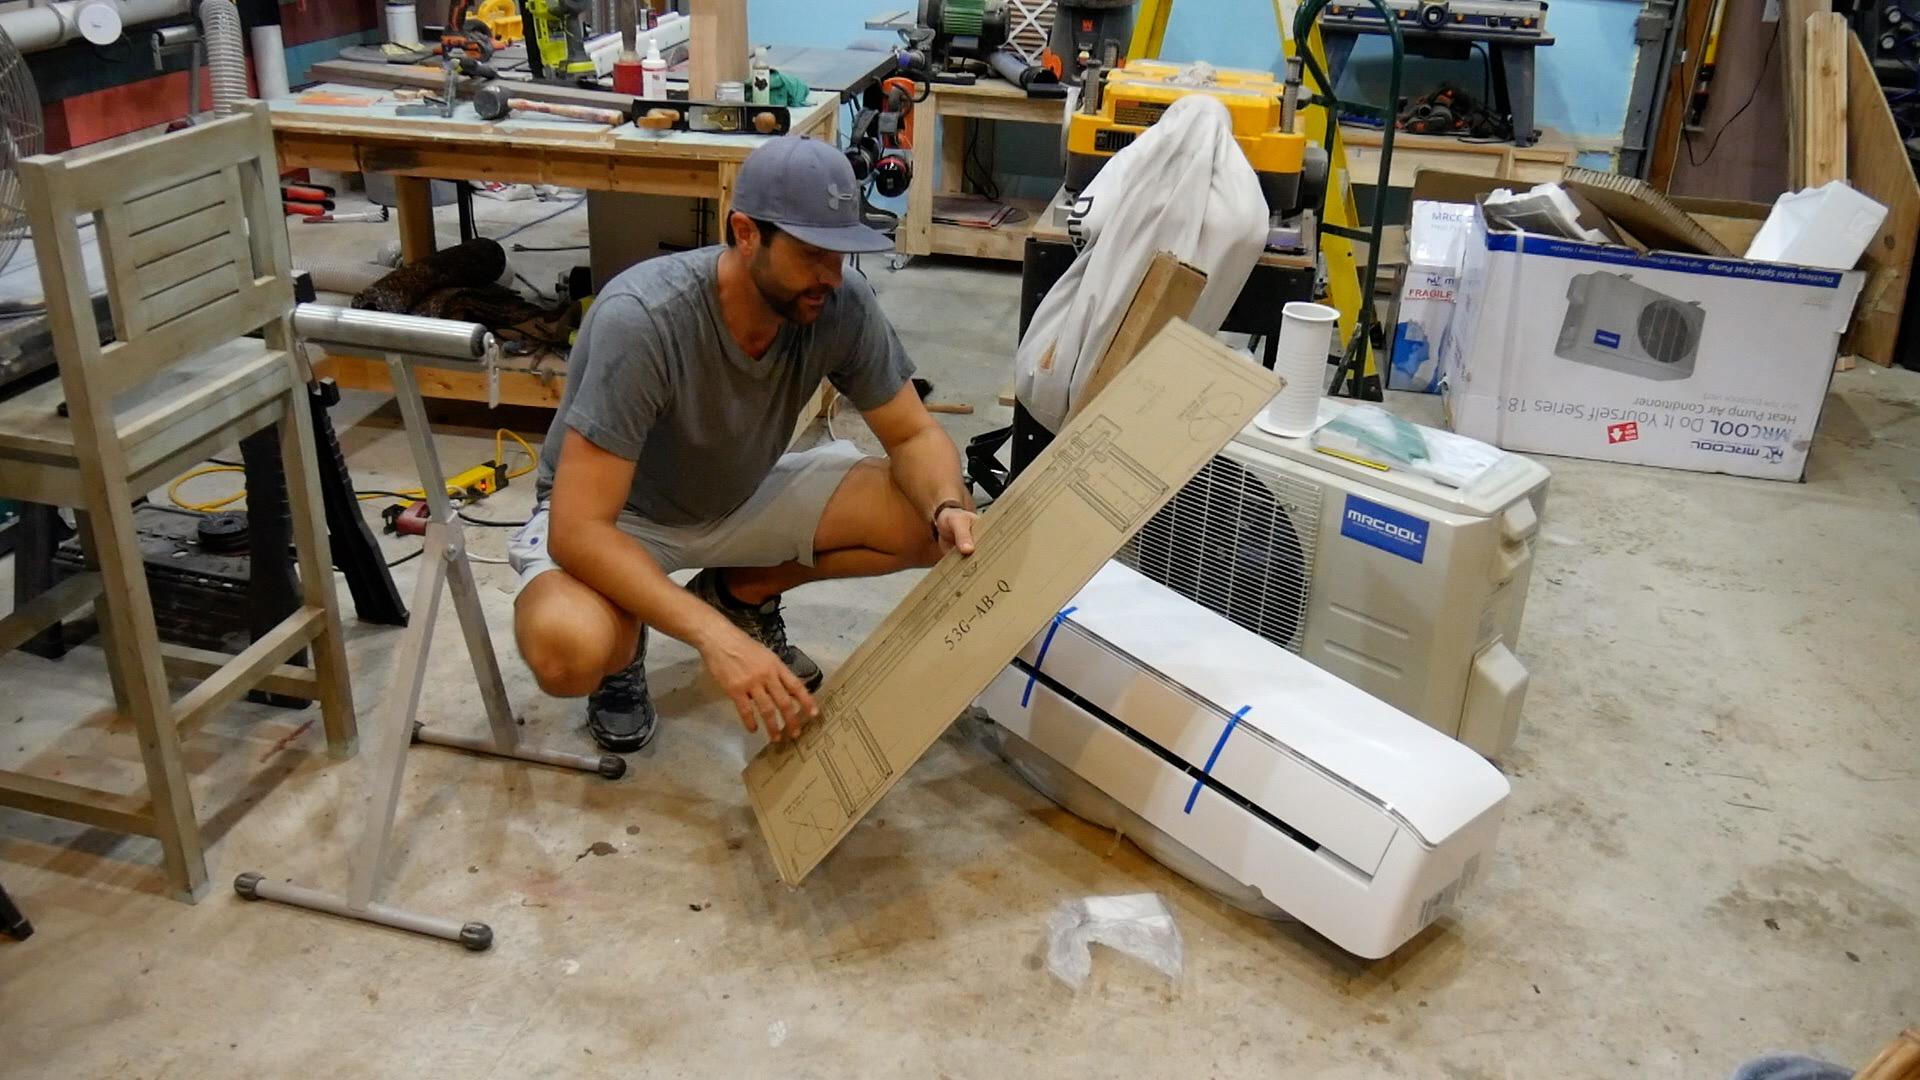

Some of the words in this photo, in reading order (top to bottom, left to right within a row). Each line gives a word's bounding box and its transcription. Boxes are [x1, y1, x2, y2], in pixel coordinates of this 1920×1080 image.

[1707, 262, 1732, 273] Pump
[1776, 270, 1798, 280] Mini
[1534, 399, 1585, 419] Series
[1632, 397, 1705, 415] Conditioner
[1707, 405, 1727, 417] Air
[1728, 406, 1764, 422] Pump
[1587, 405, 1658, 428] Yourself
[1664, 413, 1674, 430] It
[1679, 416, 1704, 433] Do
[1767, 411, 1798, 425] Heat
[1710, 419, 1792, 442] MRCOOL
[1690, 440, 1760, 456] MRCOOL
[1347, 508, 1422, 545] MRCOOL
